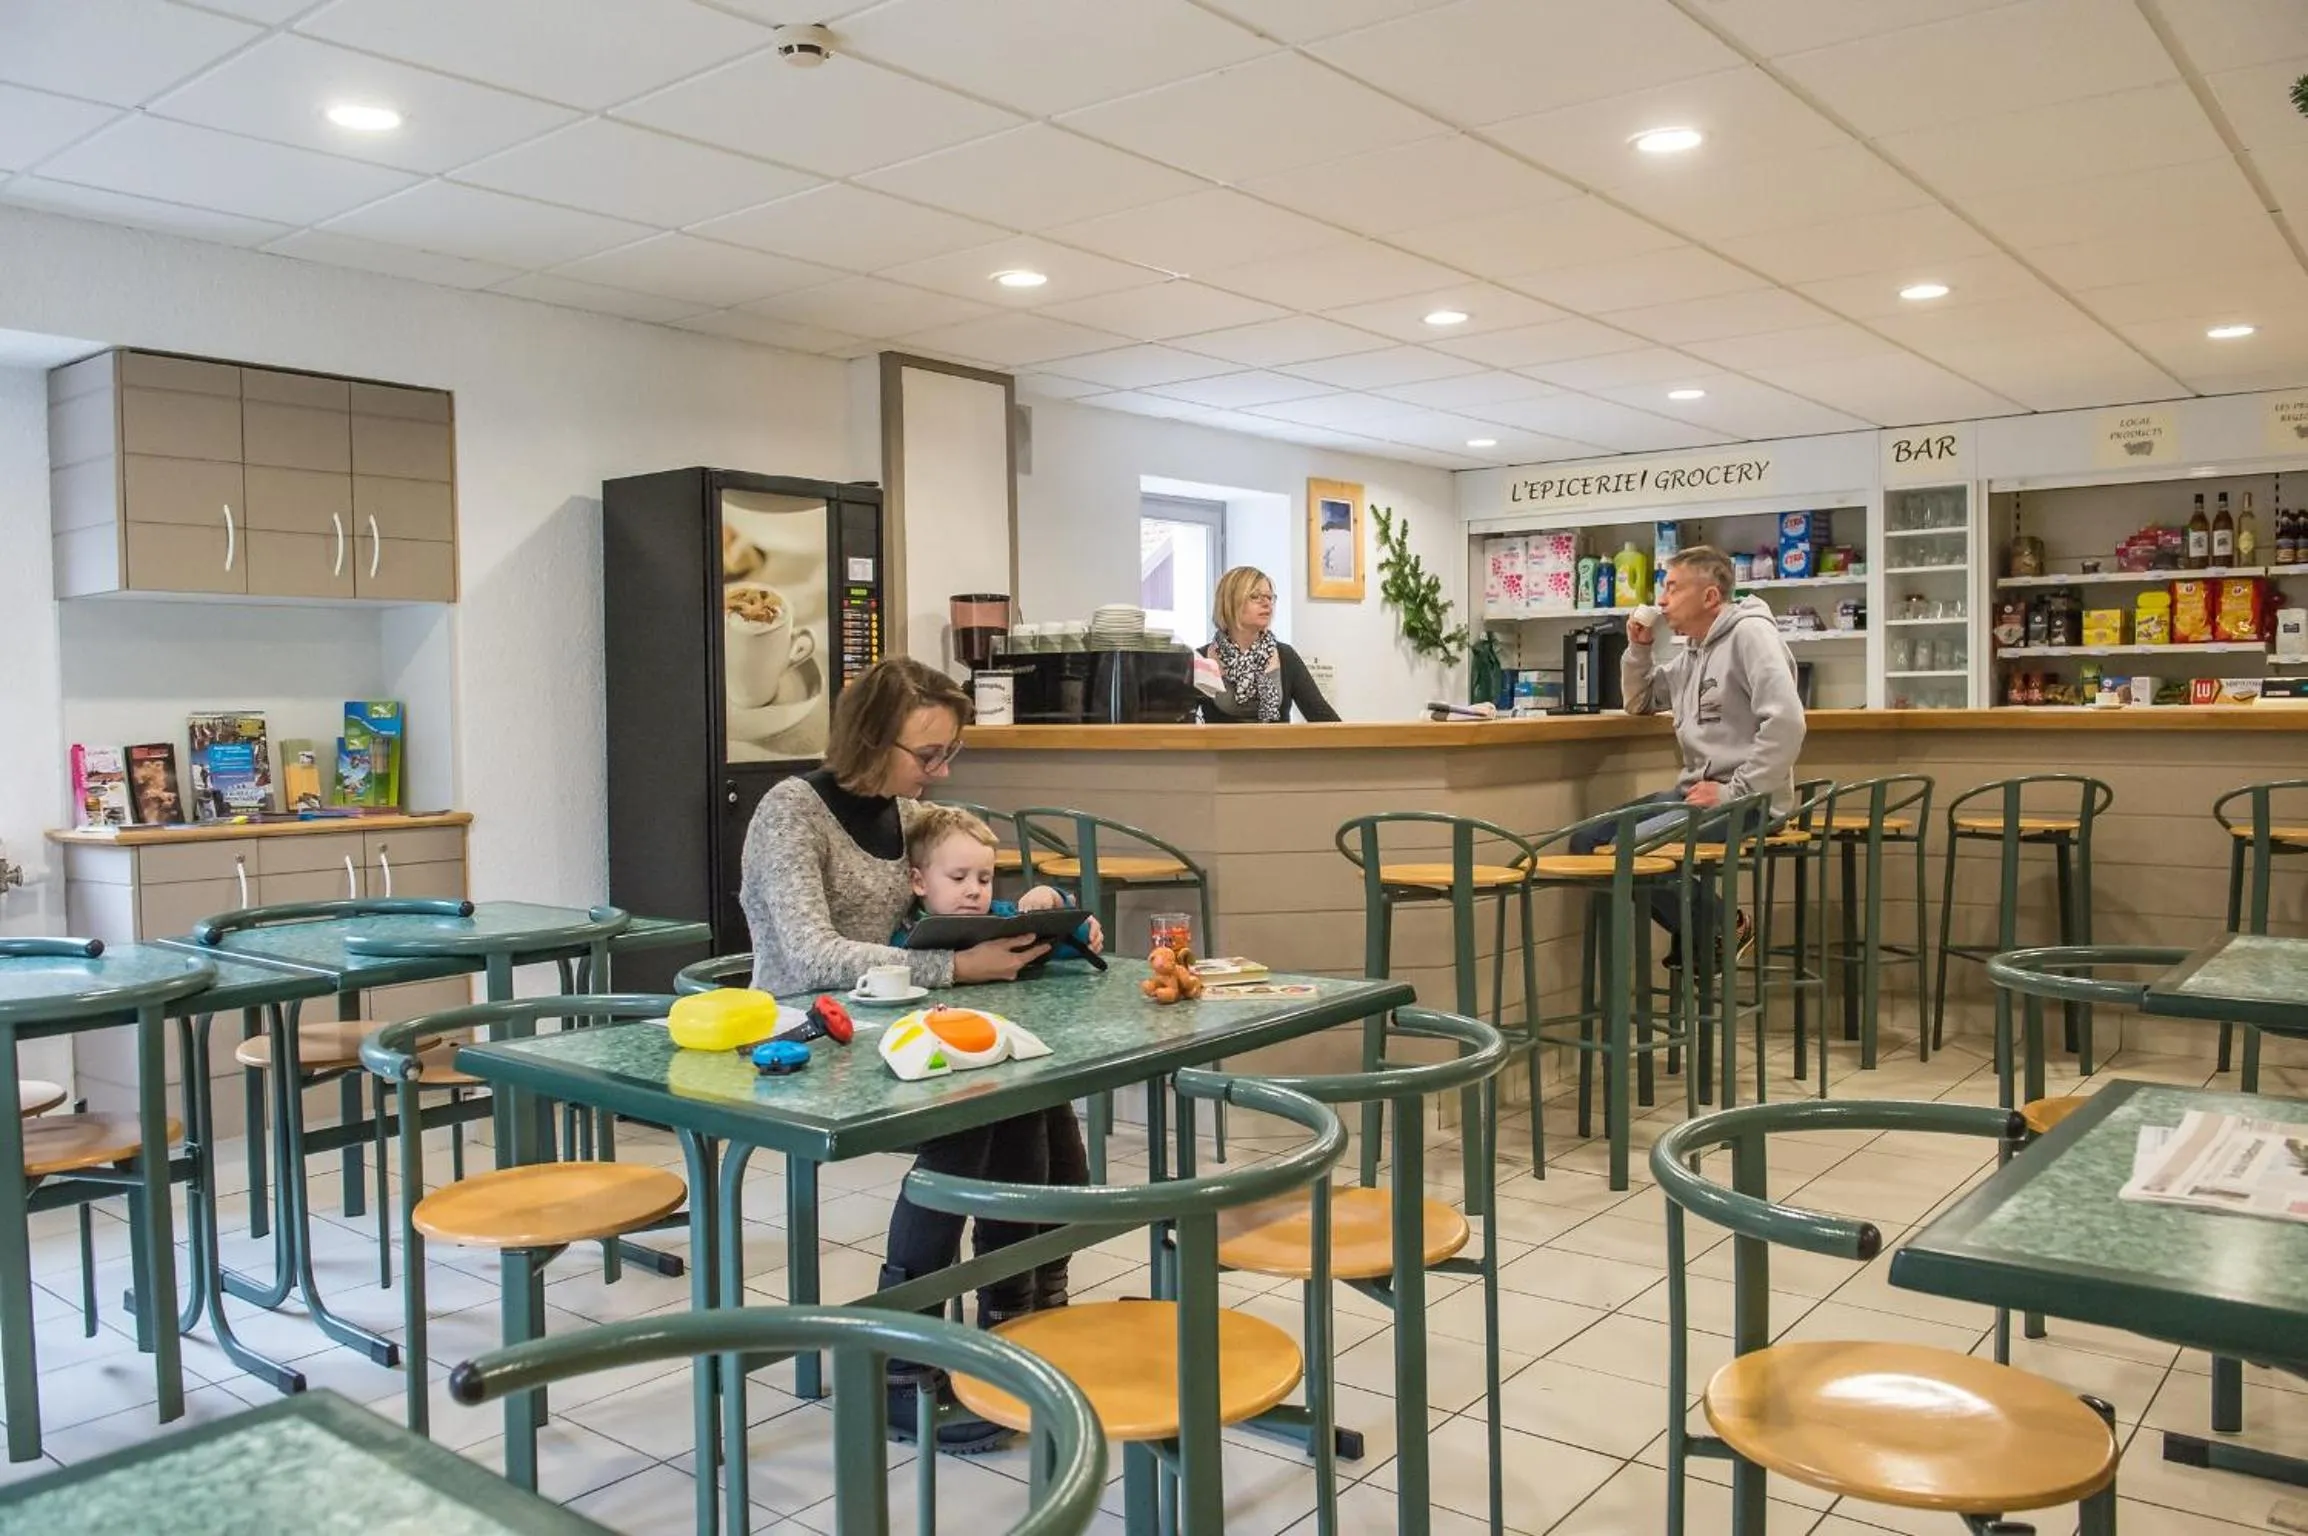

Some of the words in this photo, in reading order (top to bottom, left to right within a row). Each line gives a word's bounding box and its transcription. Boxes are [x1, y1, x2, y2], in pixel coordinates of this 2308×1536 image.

[2119, 416, 2151, 428] LOCAL
[2110, 427, 2163, 441] PRODUCTS
[1892, 435, 1957, 463] BAR
[1654, 460, 1771, 491] GROCERY
[2196, 682, 2211, 698] LU
